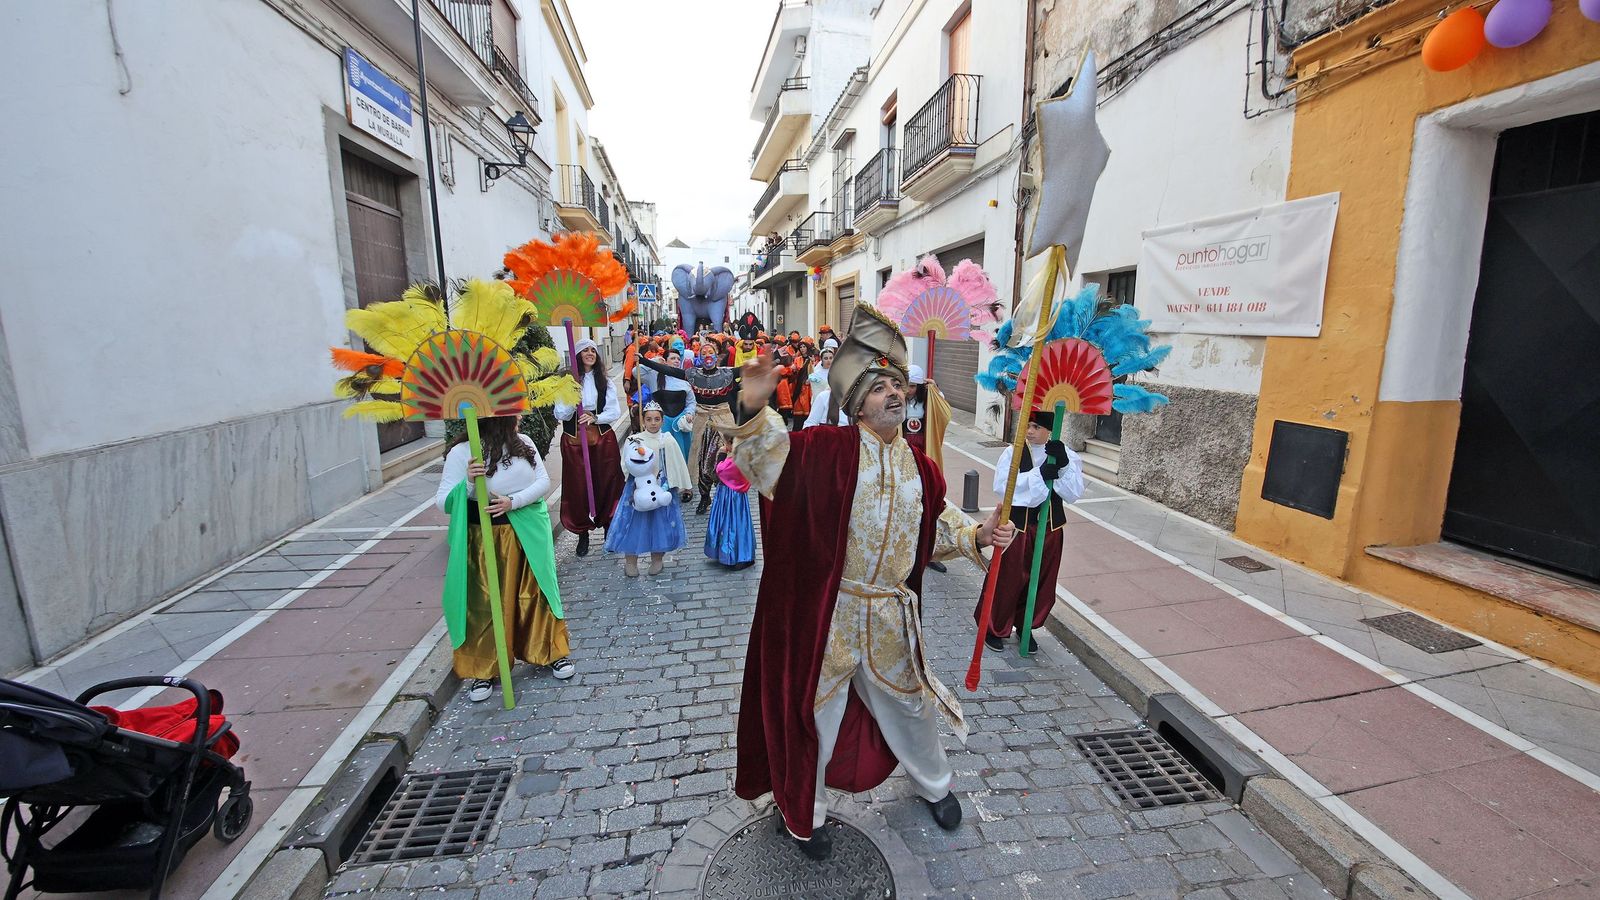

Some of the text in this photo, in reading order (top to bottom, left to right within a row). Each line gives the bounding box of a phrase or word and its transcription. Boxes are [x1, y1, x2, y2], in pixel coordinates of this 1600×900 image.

[356, 97, 411, 139] CENTRO DE BARRIO
[368, 120, 404, 148] LA MURALLA
[1175, 242, 1266, 271] puntohogar
[1198, 286, 1231, 297] VENDE
[1167, 303, 1200, 313] WATSUP
[1247, 301, 1267, 313] 018
[755, 877, 842, 898] SANEAMIENTO
